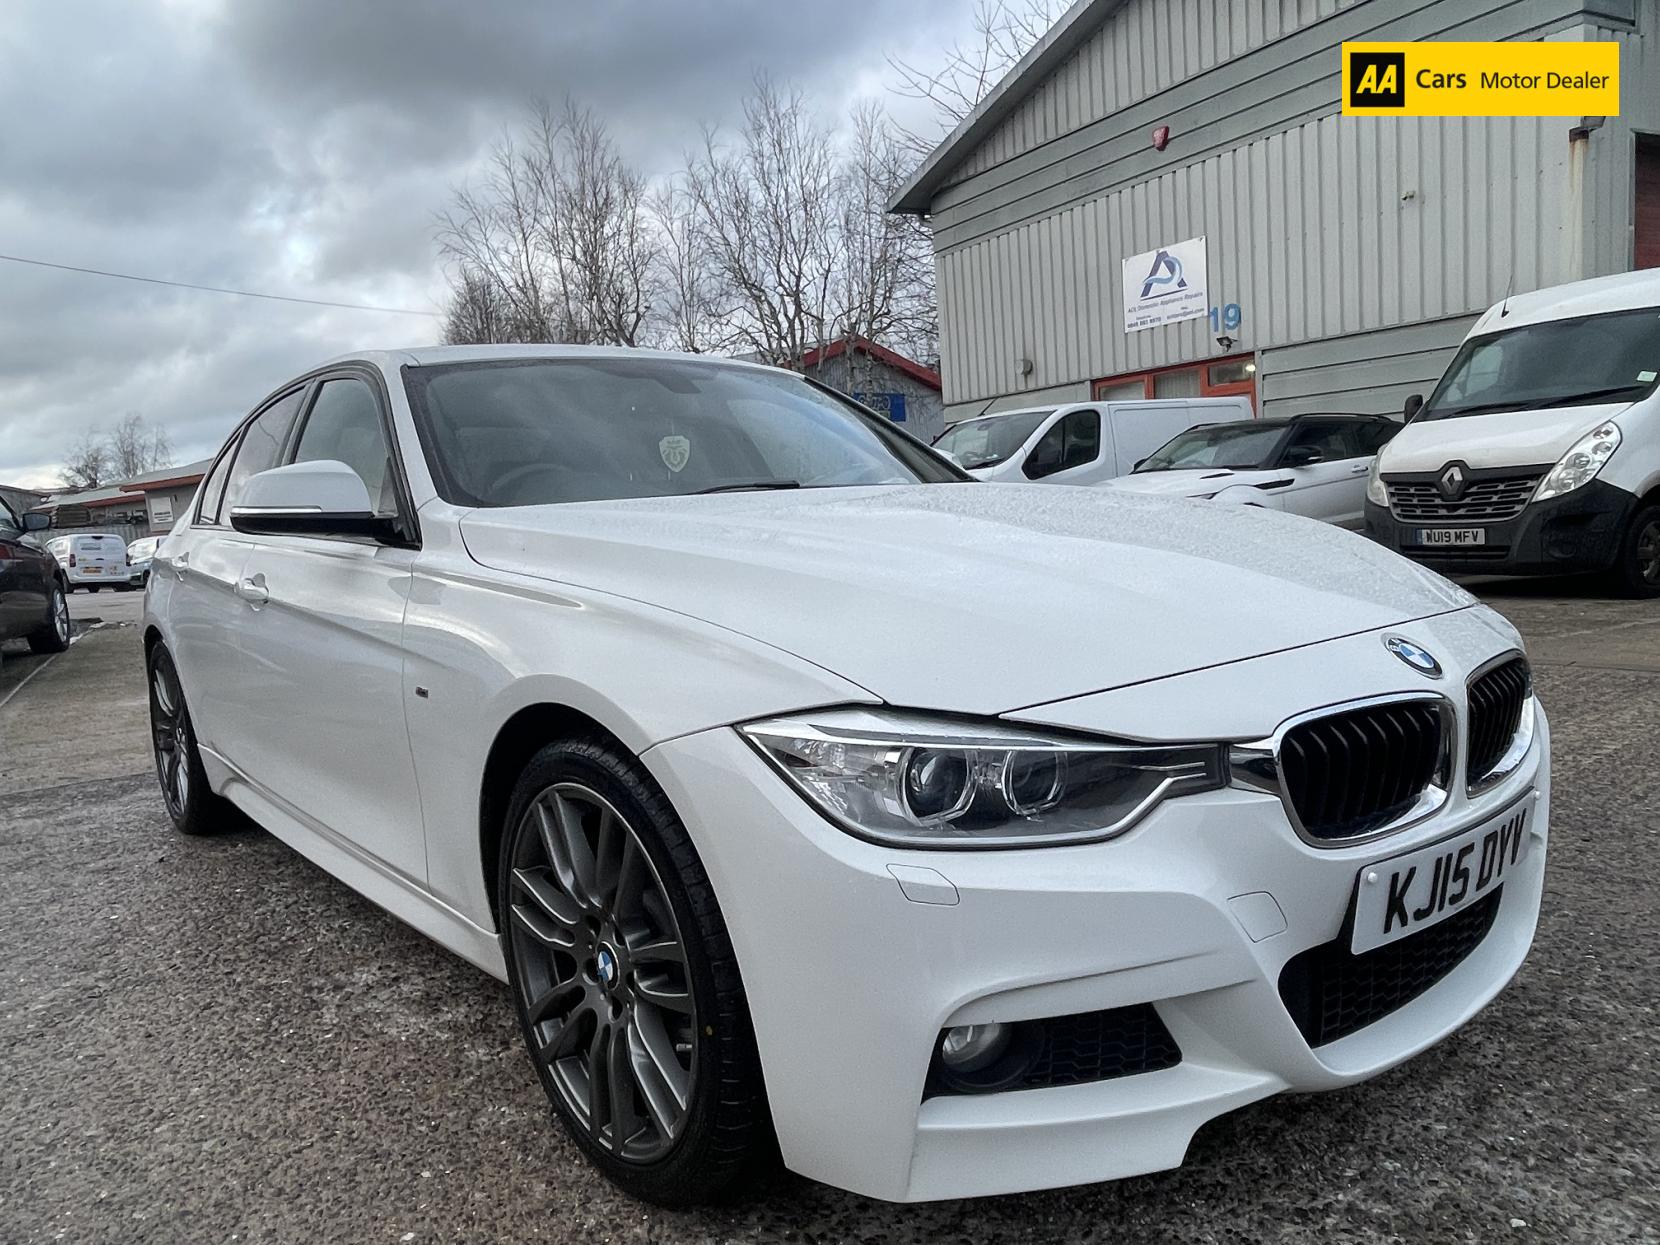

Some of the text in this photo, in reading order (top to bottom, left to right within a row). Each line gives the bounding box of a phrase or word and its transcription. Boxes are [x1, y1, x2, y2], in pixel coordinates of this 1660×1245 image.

[1210, 303, 1241, 332] 19
[1454, 530, 1479, 543] MFV
[1383, 807, 1527, 934] KJ15 DYV
